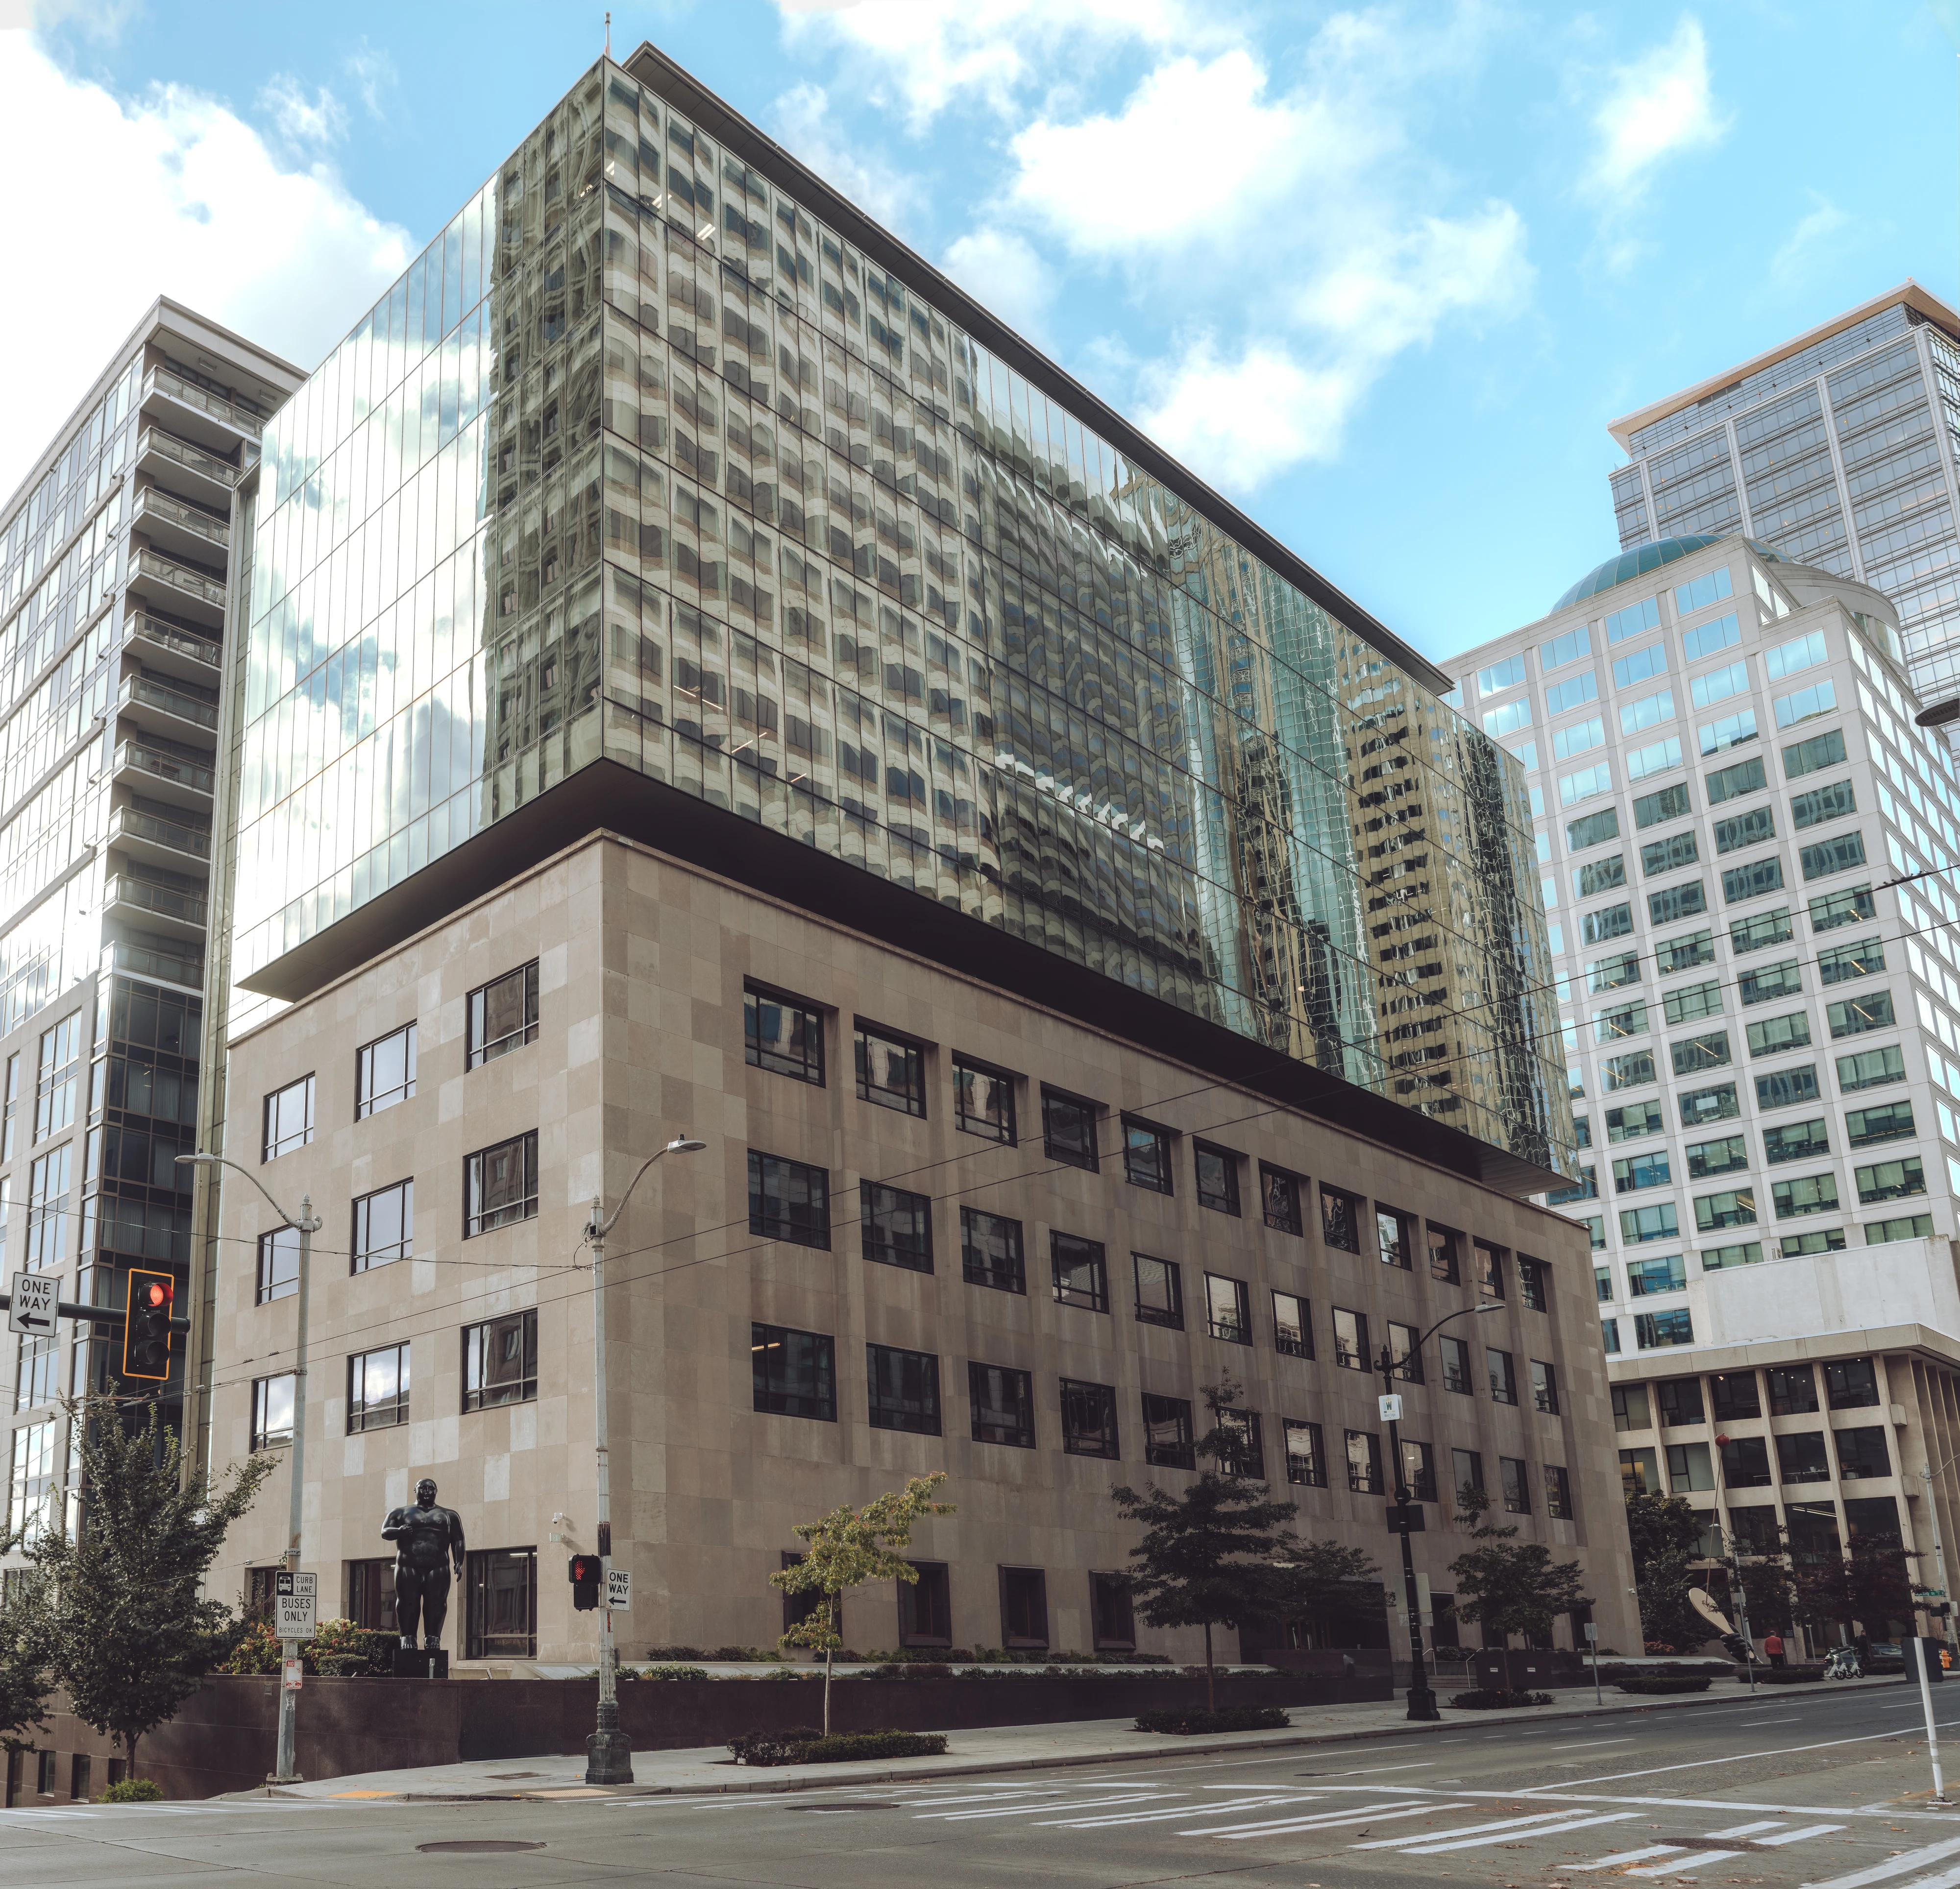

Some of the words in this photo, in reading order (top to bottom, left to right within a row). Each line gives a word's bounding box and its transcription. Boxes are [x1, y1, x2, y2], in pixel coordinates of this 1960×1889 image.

[22, 1279, 51, 1295] ONE
[20, 1295, 51, 1310] WAY
[609, 1572, 628, 1583] ONE
[609, 1583, 629, 1595] WAY
[282, 1598, 311, 1609] BUSES
[284, 1611, 308, 1622] ONLY
